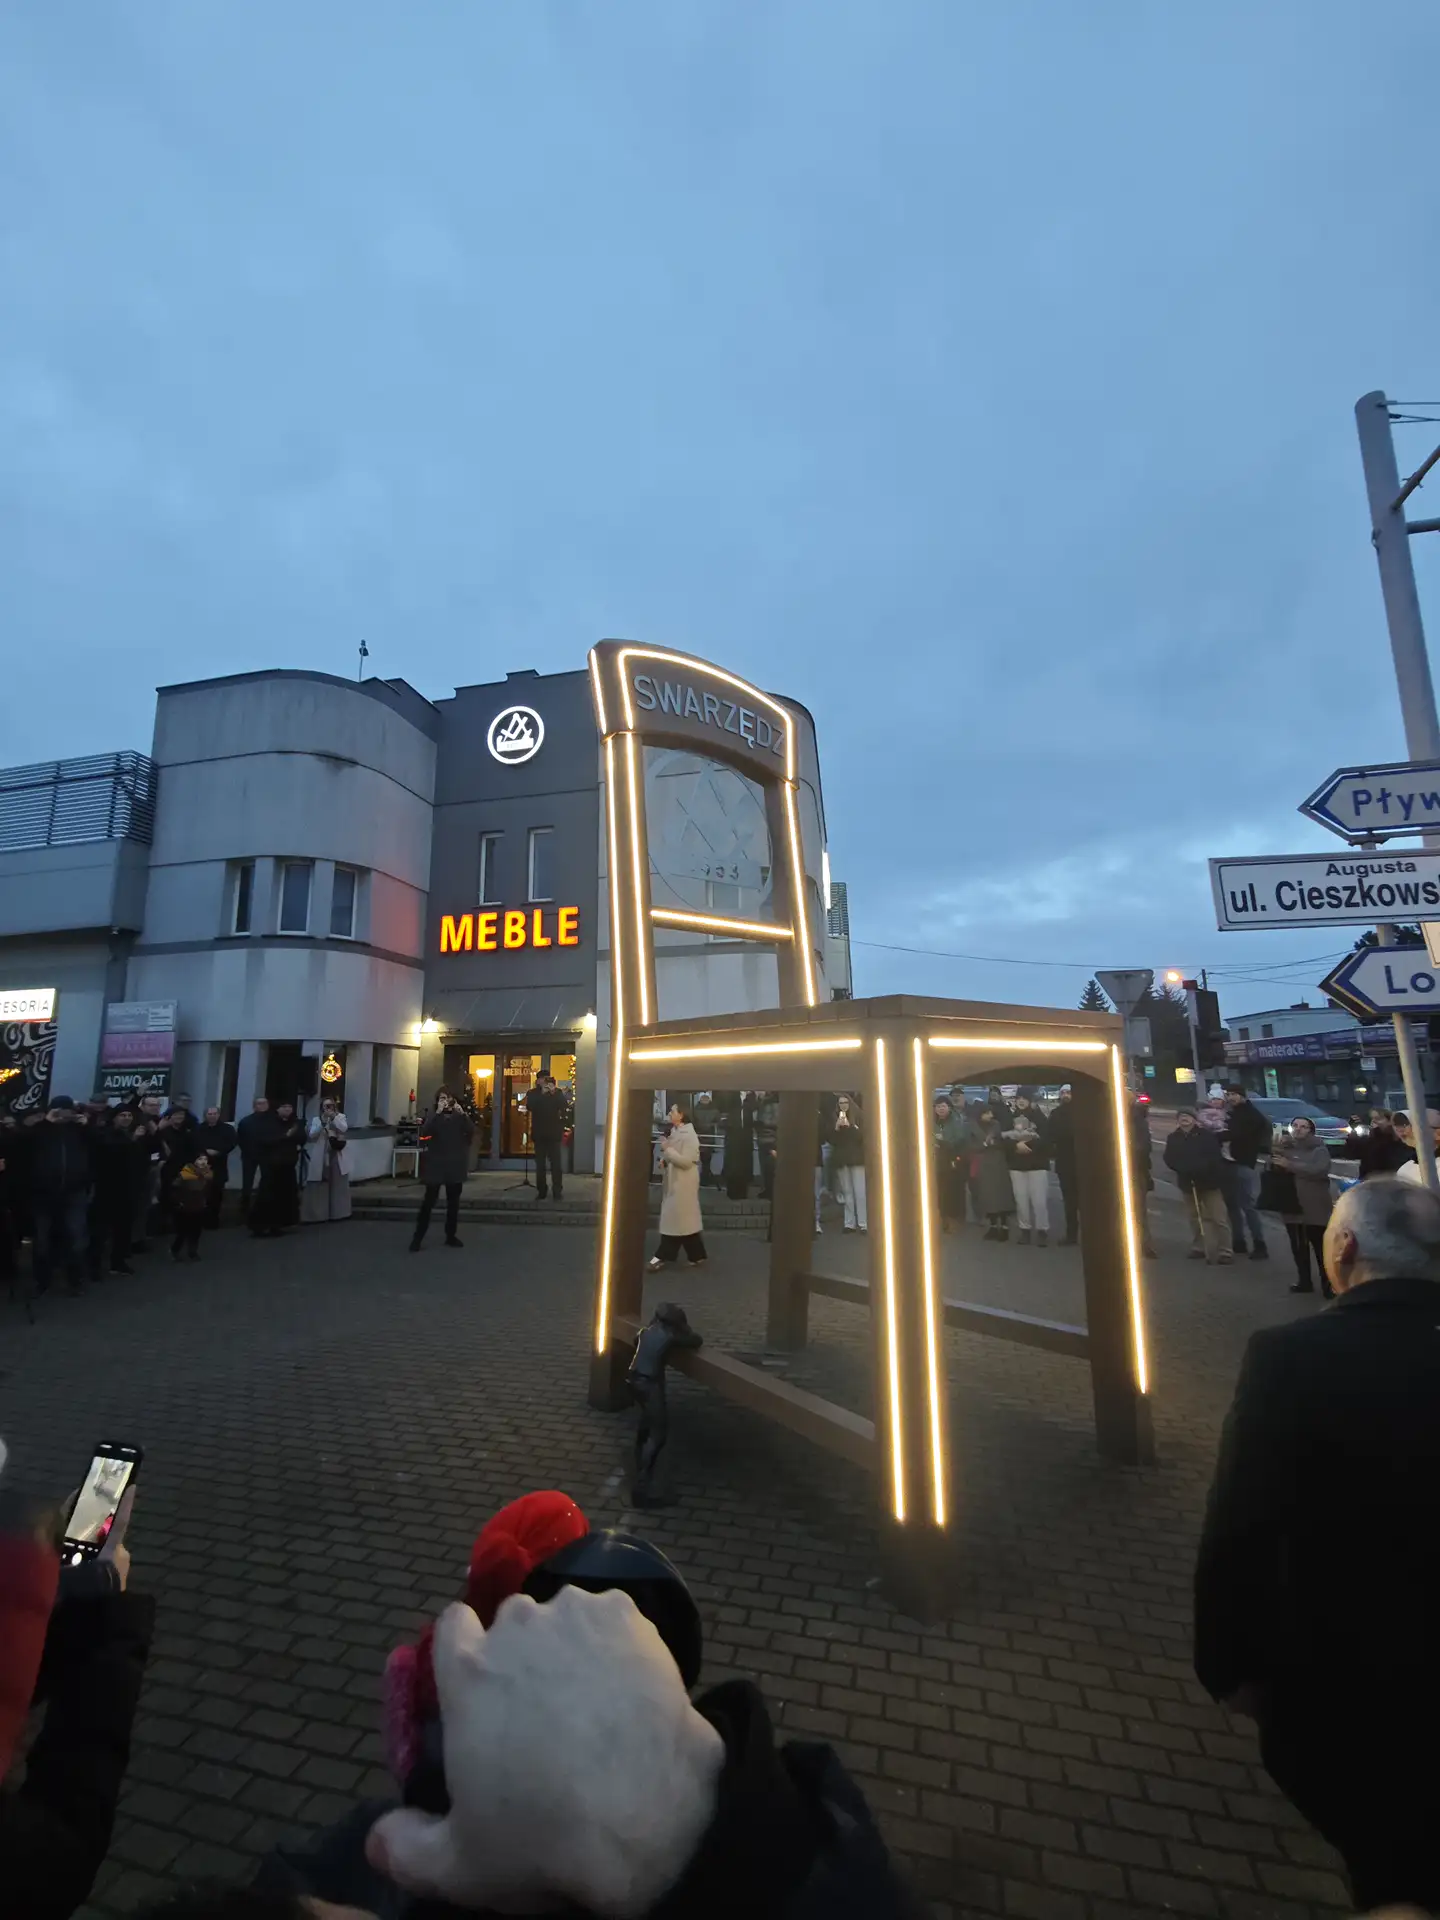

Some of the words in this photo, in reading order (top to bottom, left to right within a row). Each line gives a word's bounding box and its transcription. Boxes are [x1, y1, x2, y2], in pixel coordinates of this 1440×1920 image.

[633, 675, 784, 757] SWARZĘDZ
[1325, 861, 1417, 879] Augusta
[1230, 883, 1267, 913] ul.
[1275, 874, 1440, 912] Cieszkows
[440, 906, 579, 953] MEBLE
[1384, 965, 1436, 994] Lo
[0, 1000, 50, 1014] ESORIA
[1258, 1042, 1305, 1058] materace
[104, 1074, 165, 1087] ADWOAT
